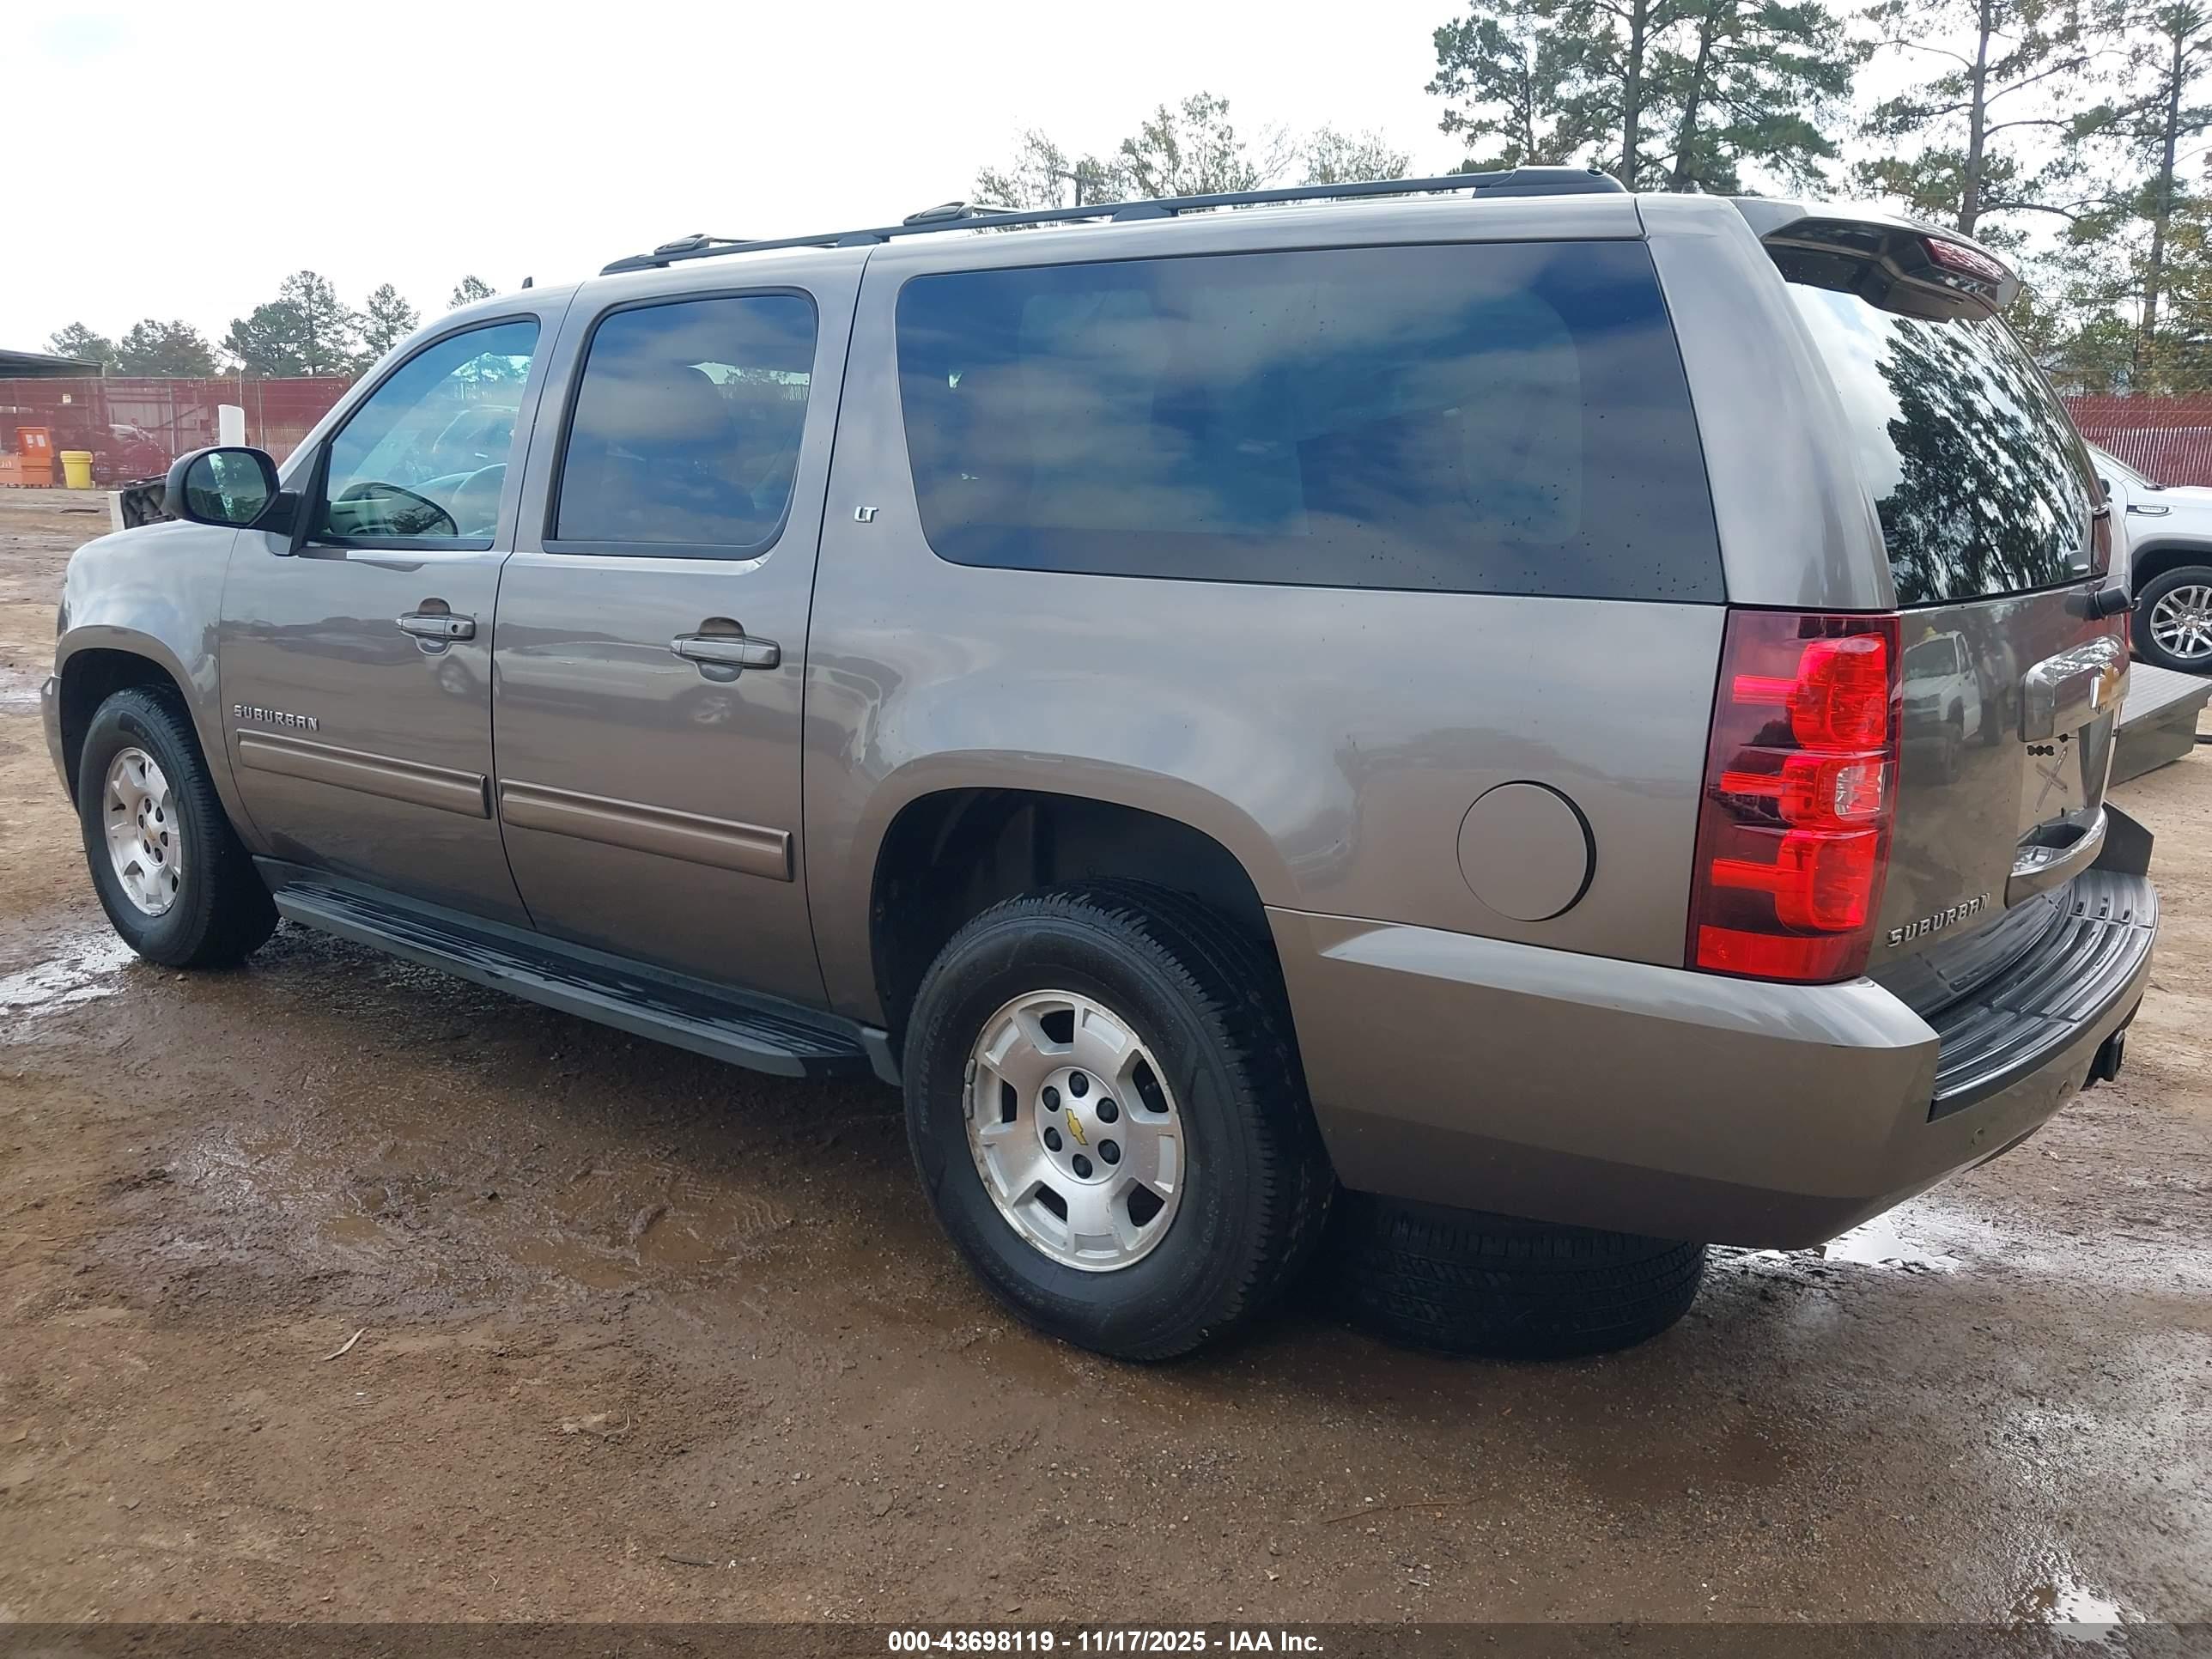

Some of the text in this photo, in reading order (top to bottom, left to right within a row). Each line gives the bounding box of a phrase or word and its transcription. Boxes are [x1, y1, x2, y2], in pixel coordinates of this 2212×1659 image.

[854, 506, 878, 523] LT
[234, 704, 318, 732] SUBURBAN
[1887, 892, 1990, 947] SUBURBAN
